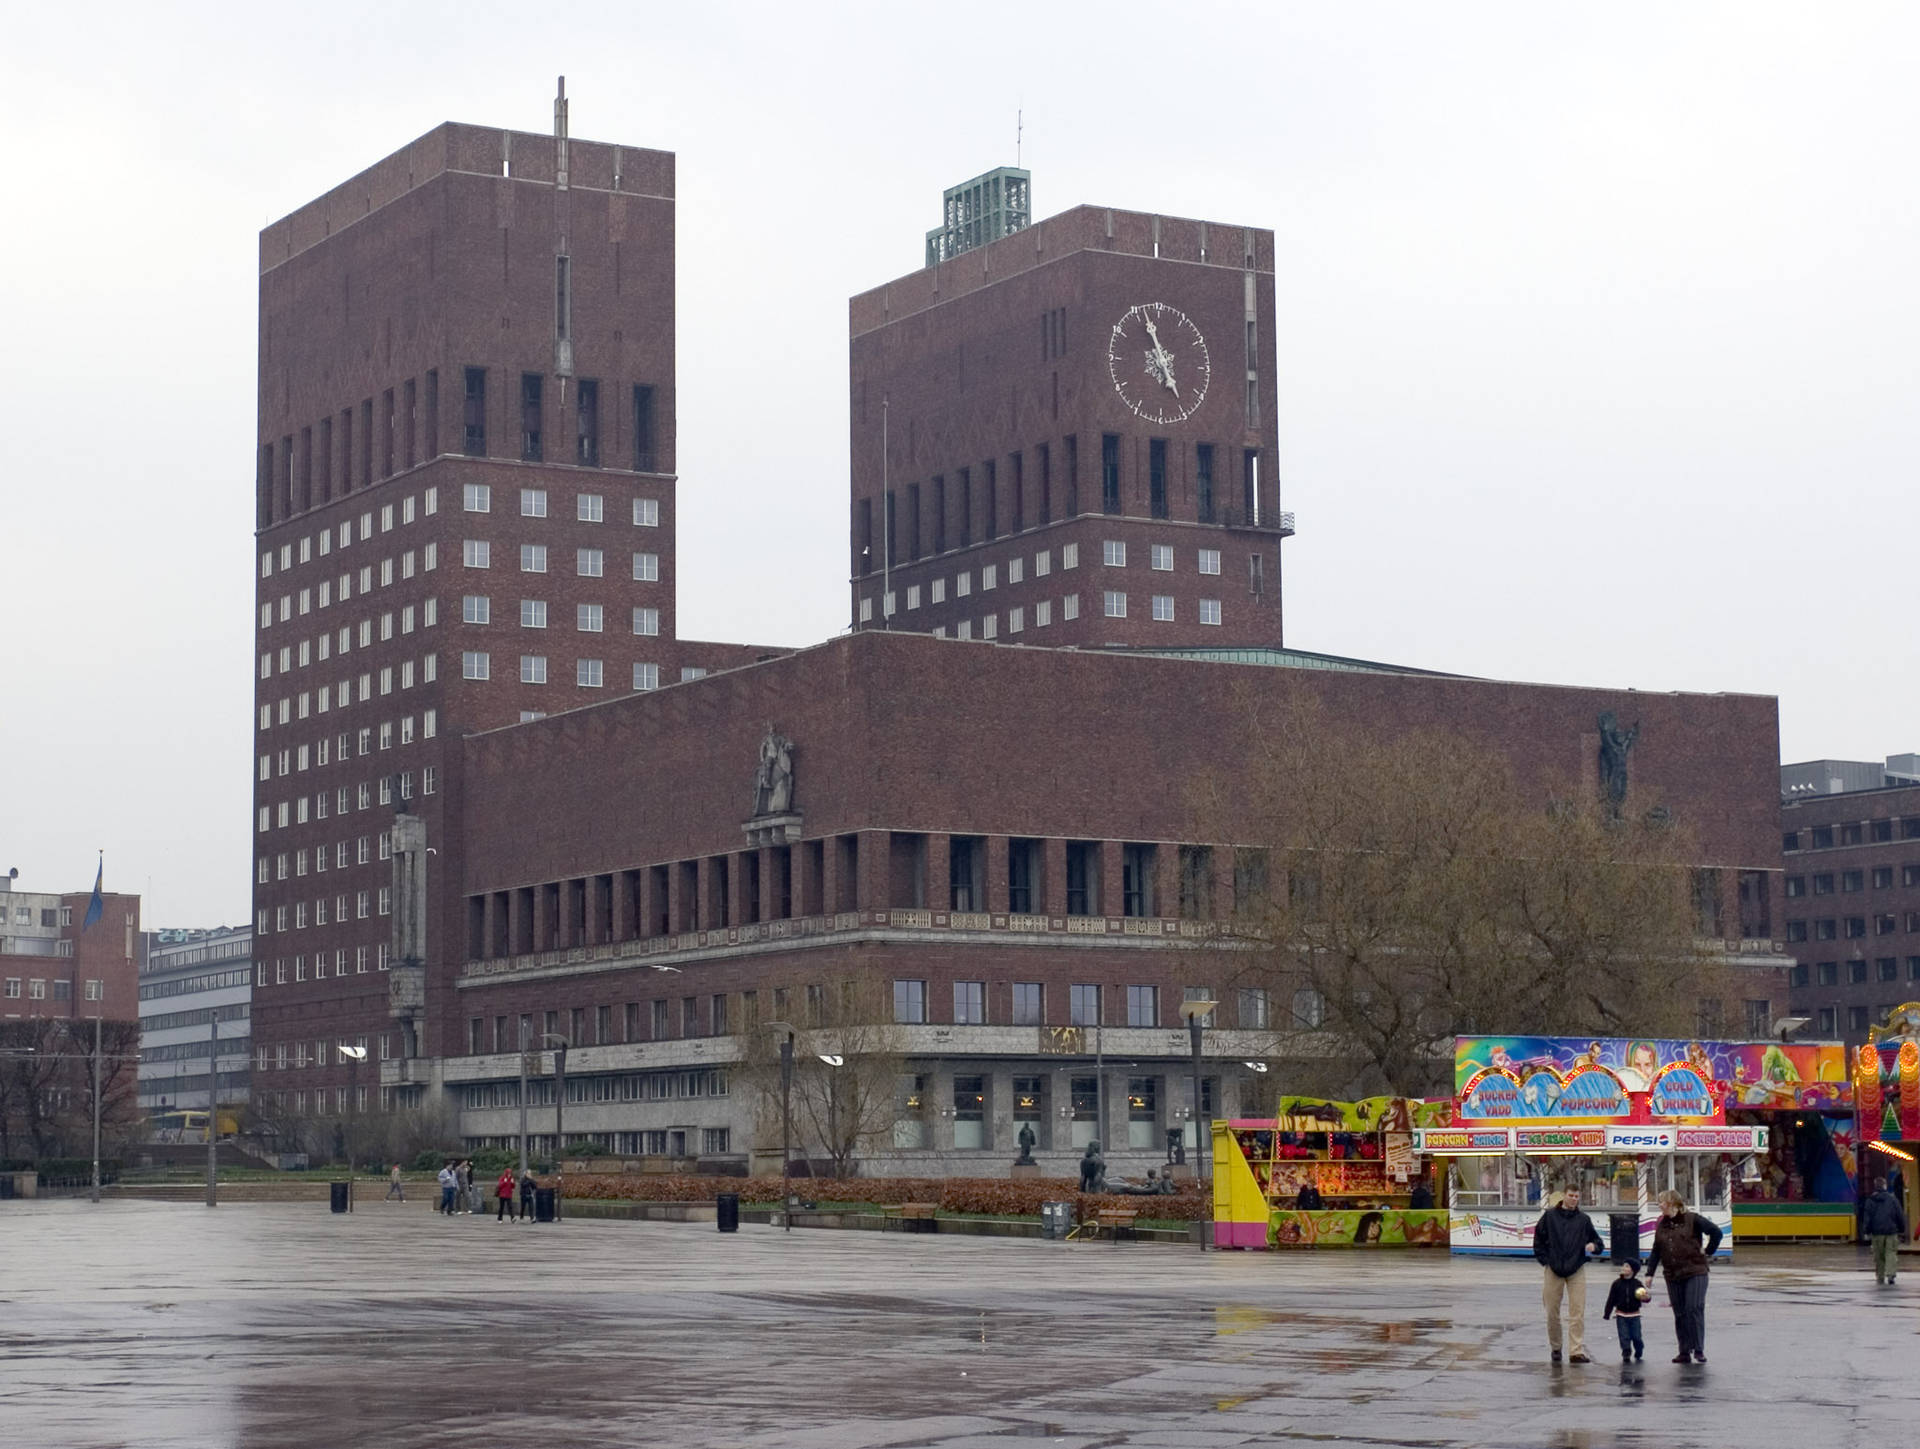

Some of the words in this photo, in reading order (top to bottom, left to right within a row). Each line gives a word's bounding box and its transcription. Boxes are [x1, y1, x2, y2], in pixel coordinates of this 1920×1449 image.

[1666, 1082, 1693, 1091] COLD
[1479, 1090, 1517, 1101] SOCKER
[1561, 1098, 1616, 1110] POPCORN
[1663, 1099, 1701, 1110] DRINKS
[1486, 1105, 1511, 1116] VADD
[1426, 1134, 1468, 1147] POPCORN
[1613, 1136, 1657, 1145] PEPSI
